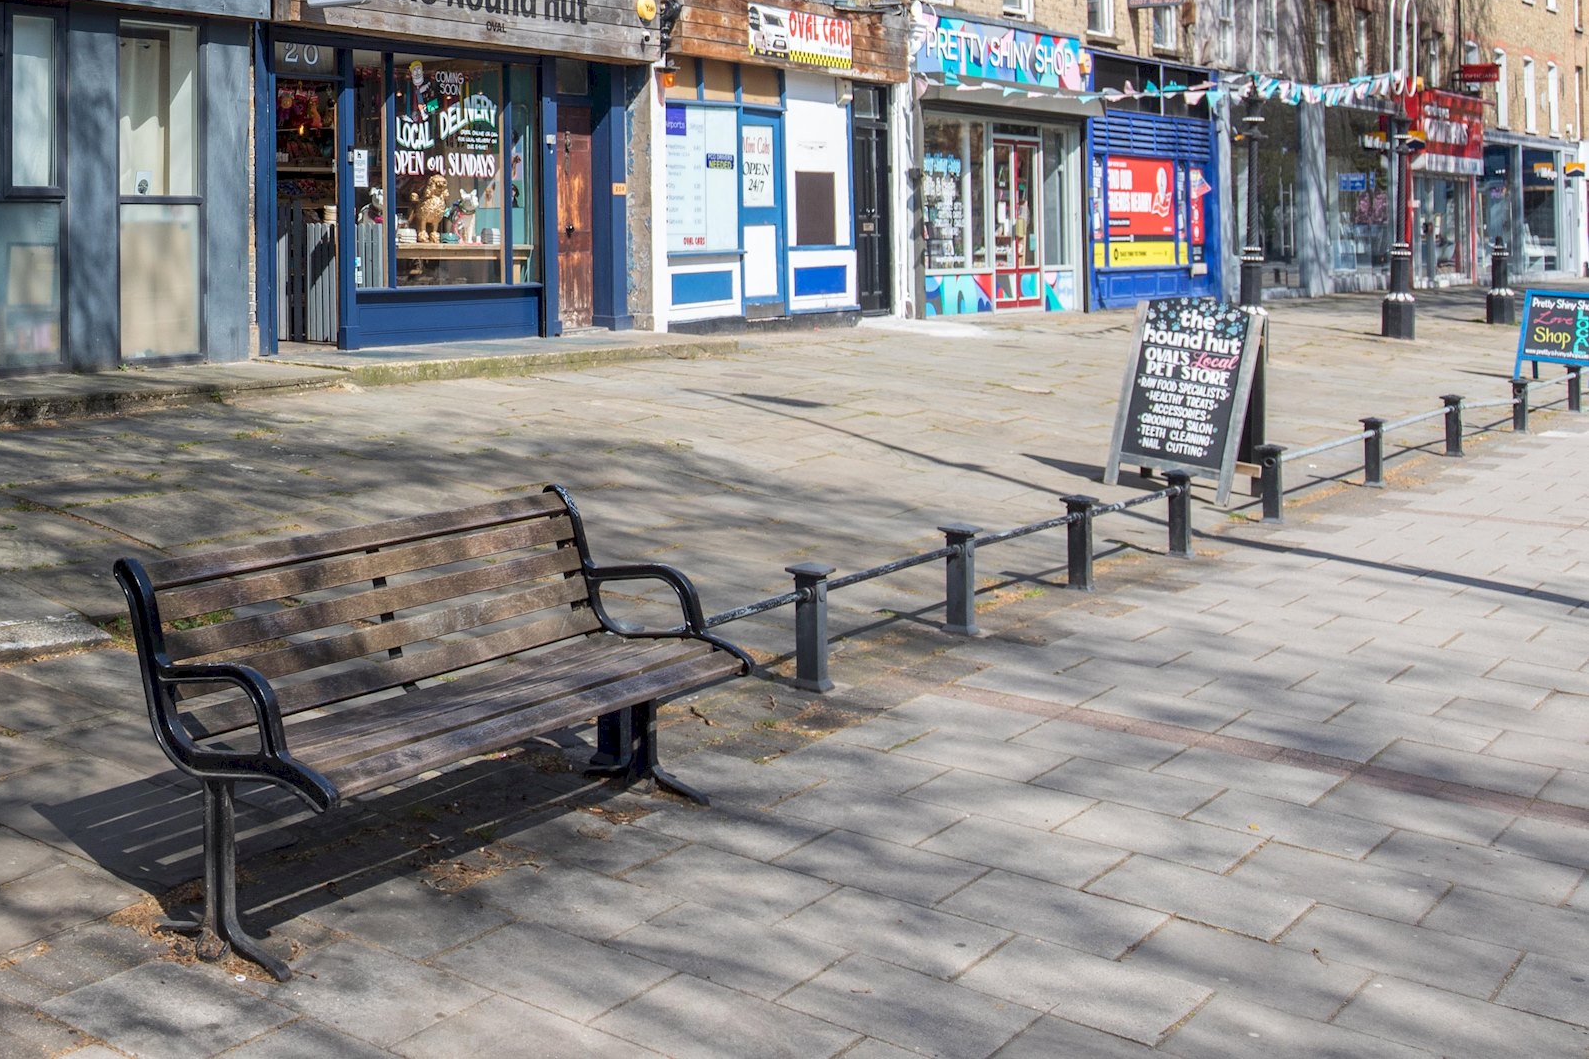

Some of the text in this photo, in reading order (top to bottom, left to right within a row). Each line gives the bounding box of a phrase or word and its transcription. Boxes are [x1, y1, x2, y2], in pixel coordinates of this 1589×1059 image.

[486, 20, 507, 34] OVAL
[789, 11, 850, 47] OVAL CARS
[285, 43, 319, 65] 20
[926, 27, 1074, 76] PRETTY SHINY SHOP
[435, 71, 464, 85] COMING
[439, 83, 461, 95] SOON
[396, 94, 498, 150] LOCAL DELIVERY
[742, 136, 770, 155] Mini Cabs
[394, 150, 425, 176] OPEN
[427, 155, 446, 176] on
[448, 152, 496, 178] SUNDAYS
[709, 161, 732, 169] NEEDED
[742, 161, 771, 176] OPEN
[748, 179, 765, 193] 24/7
[683, 237, 705, 245] OVAL CARS
[1532, 297, 1589, 311] Pretty Shiny Sho
[1180, 309, 1216, 330] the
[1533, 310, 1573, 325] Love
[1143, 322, 1242, 355] hound hut
[1534, 326, 1571, 350] Shop
[1145, 347, 1239, 371] OVAL'S Local
[1146, 361, 1231, 387] PET STORE
[1140, 377, 1227, 401] RAW FOOD SPECIALISTS
[1149, 390, 1215, 410] HEALTHY TREATS
[1152, 403, 1207, 421] ACCESSORIES
[1141, 412, 1213, 435] GROOMING SALON
[1141, 424, 1210, 447] TEETH CLEANING
[1142, 436, 1203, 457] NAIL CUTTING
